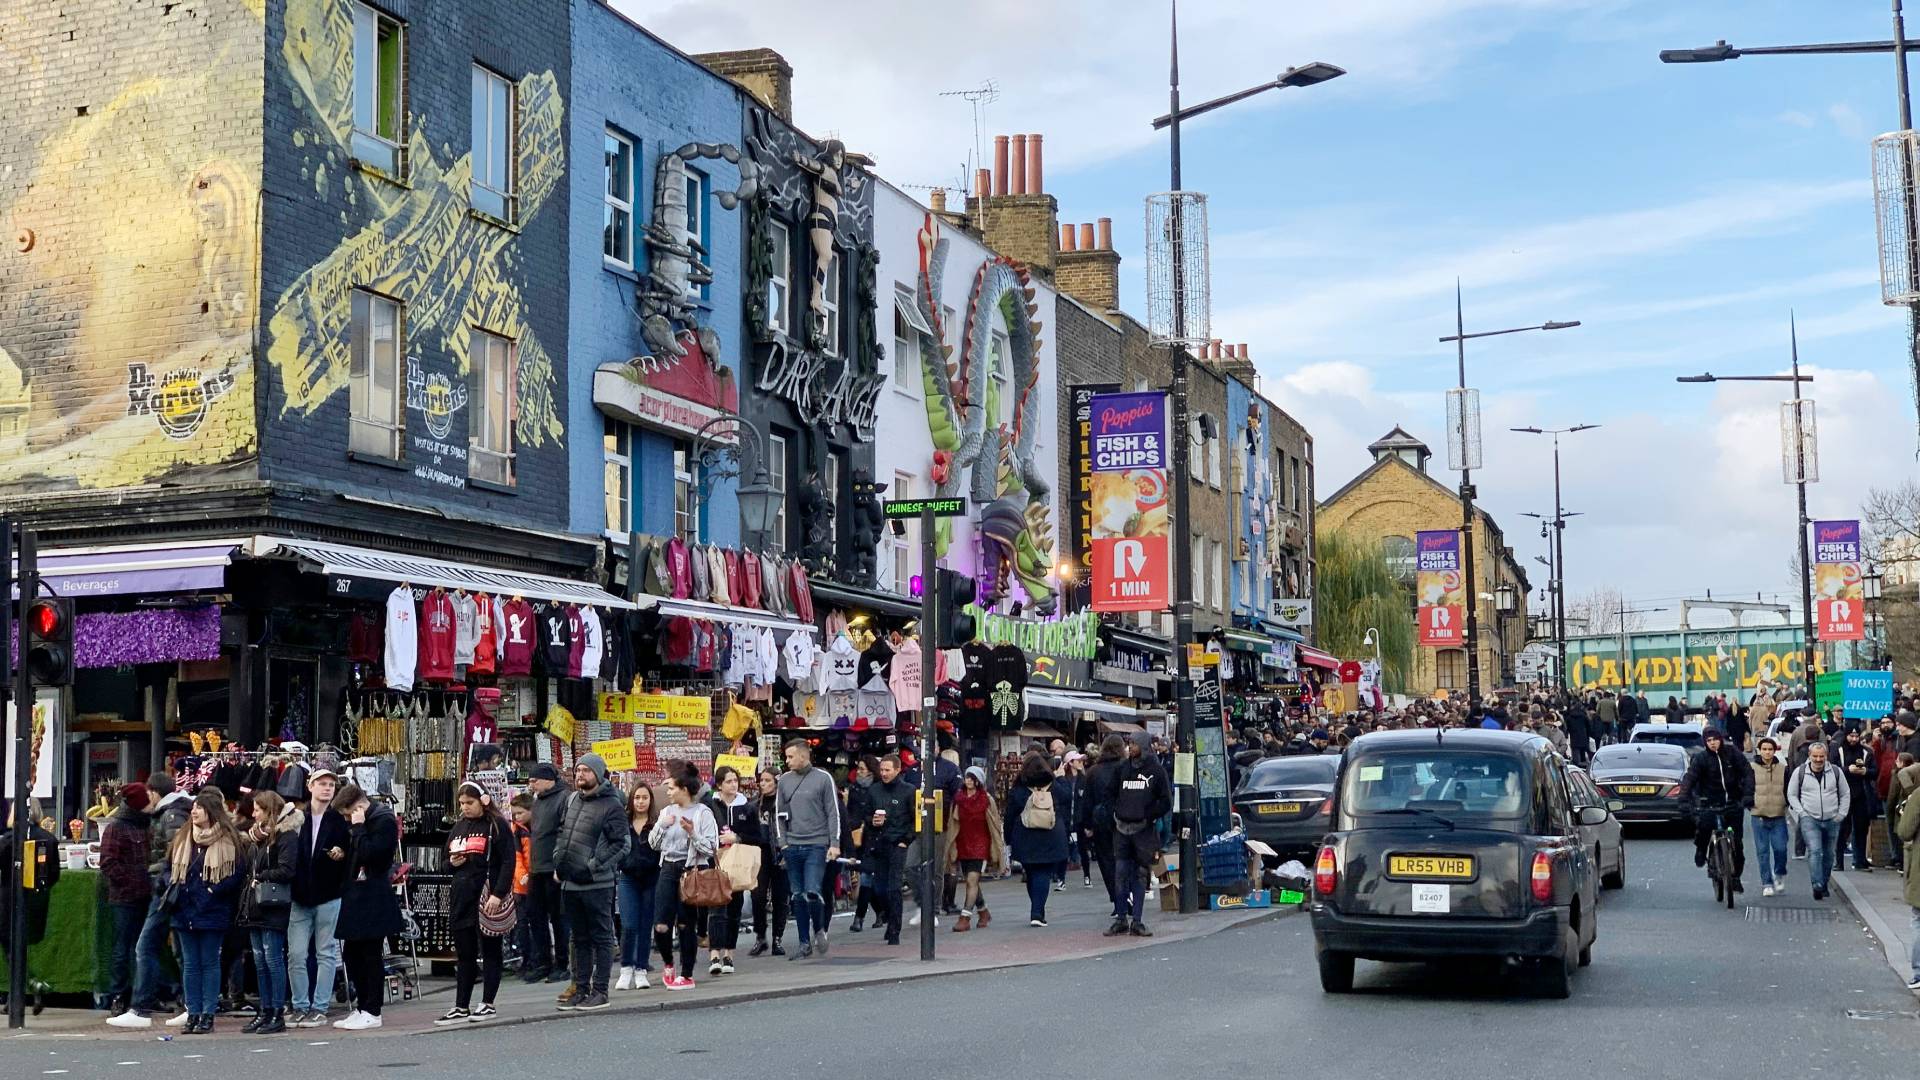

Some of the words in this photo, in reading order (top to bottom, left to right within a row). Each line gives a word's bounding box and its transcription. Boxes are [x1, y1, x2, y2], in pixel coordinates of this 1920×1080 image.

[761, 334, 825, 424] DARK
[127, 367, 235, 416] Martens
[407, 382, 468, 411] Martens
[1101, 400, 1154, 434] Poppies
[426, 440, 434, 451] US
[440, 443, 449, 455] THE
[1097, 437, 1138, 452] FISH
[1143, 435, 1159, 450] &
[433, 454, 442, 466] OR
[1097, 450, 1160, 467] CHIPS
[886, 502, 923, 513] CHINESE
[1818, 544, 1844, 552] FISH
[1846, 543, 1856, 552] &
[1420, 553, 1445, 561] FISH
[1447, 552, 1456, 560] &
[1818, 552, 1857, 561] CHIPS
[1420, 560, 1457, 569] CHIPS
[63, 579, 119, 593] Beverages
[336, 579, 351, 593] 267
[1110, 582, 1117, 597] 1
[1122, 581, 1151, 596] MIN
[1429, 629, 1435, 638] 2
[1436, 629, 1453, 638] MIN
[1828, 624, 1835, 632] 2
[1836, 623, 1853, 632] MIN
[1572, 654, 1718, 689] CAMDEN
[1847, 678, 1889, 689] MONEY
[604, 696, 626, 713] £1
[1844, 700, 1892, 711] CHANGE
[680, 711, 692, 719] for
[604, 752, 618, 760] for
[620, 750, 632, 758] £1
[1122, 780, 1145, 790] PUMA
[1397, 859, 1433, 873] LR55
[1438, 860, 1465, 874] VHB
